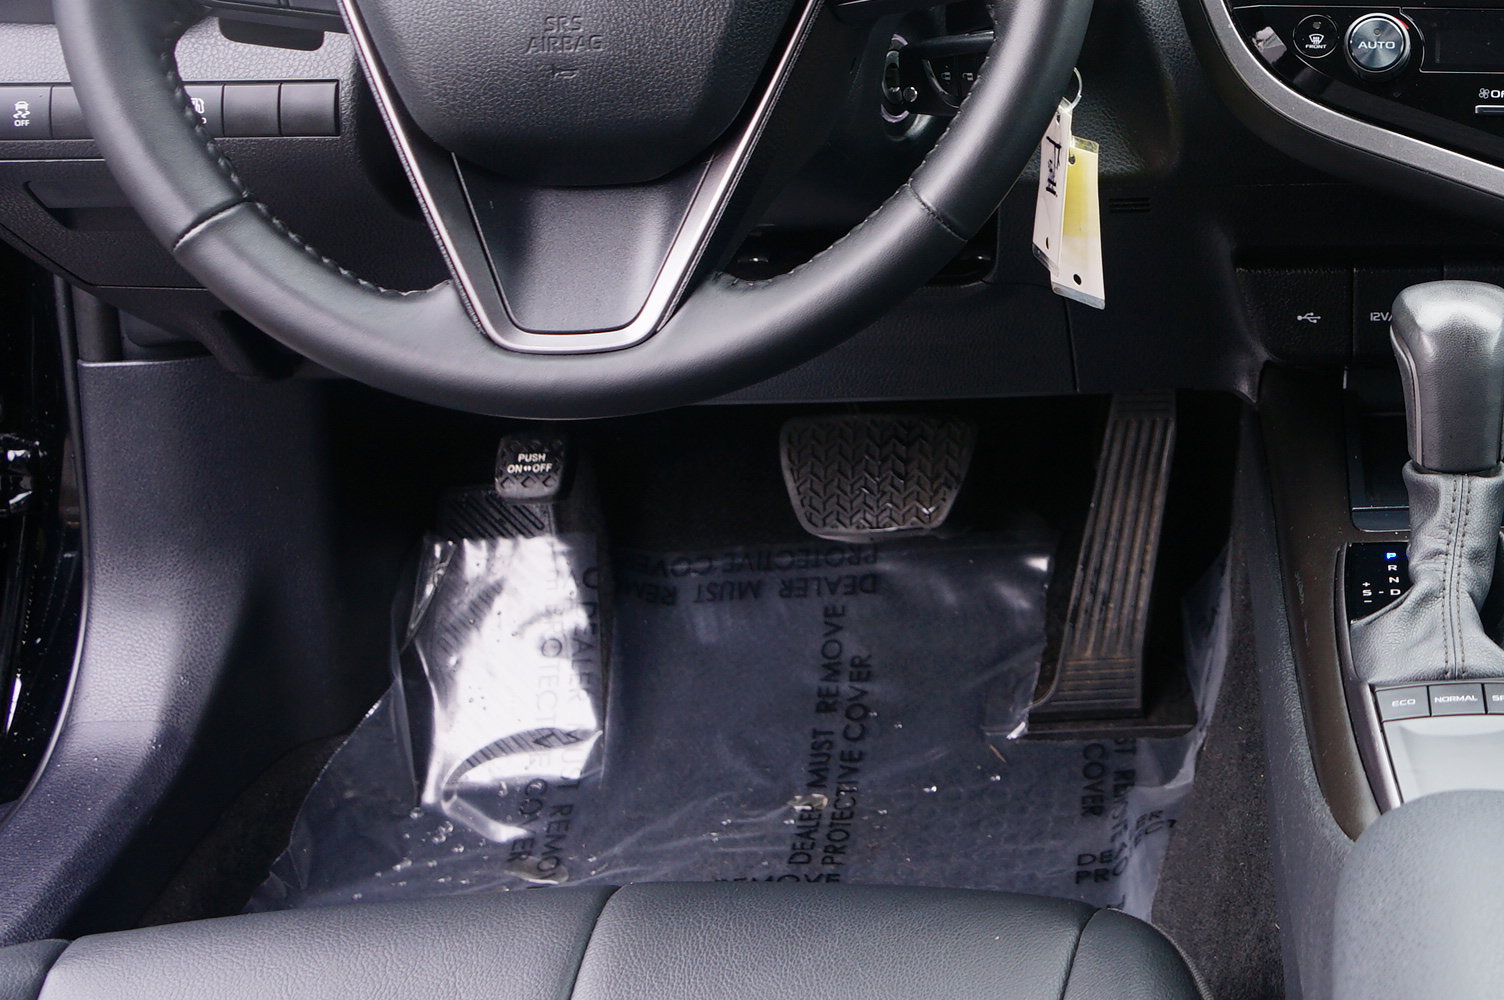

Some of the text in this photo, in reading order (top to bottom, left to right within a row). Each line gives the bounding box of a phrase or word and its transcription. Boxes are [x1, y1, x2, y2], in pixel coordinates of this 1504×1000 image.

[544, 15, 583, 33] SRS
[525, 34, 604, 55] AIRBAG
[1357, 40, 1396, 50] AUTO
[14, 119, 30, 127] OFF
[517, 453, 547, 463] PUSH
[1386, 552, 1397, 560] P
[692, 578, 762, 603] MUST
[778, 573, 878, 599] DEALER
[815, 604, 846, 714] REMOVE
[1391, 699, 1416, 708] ECO
[1434, 694, 1479, 704] NORMAL
[805, 728, 835, 788] MUST
[821, 654, 873, 866] PROTECTIVE COVER
[1080, 743, 1106, 818] COVER
[507, 778, 548, 864] COVER
